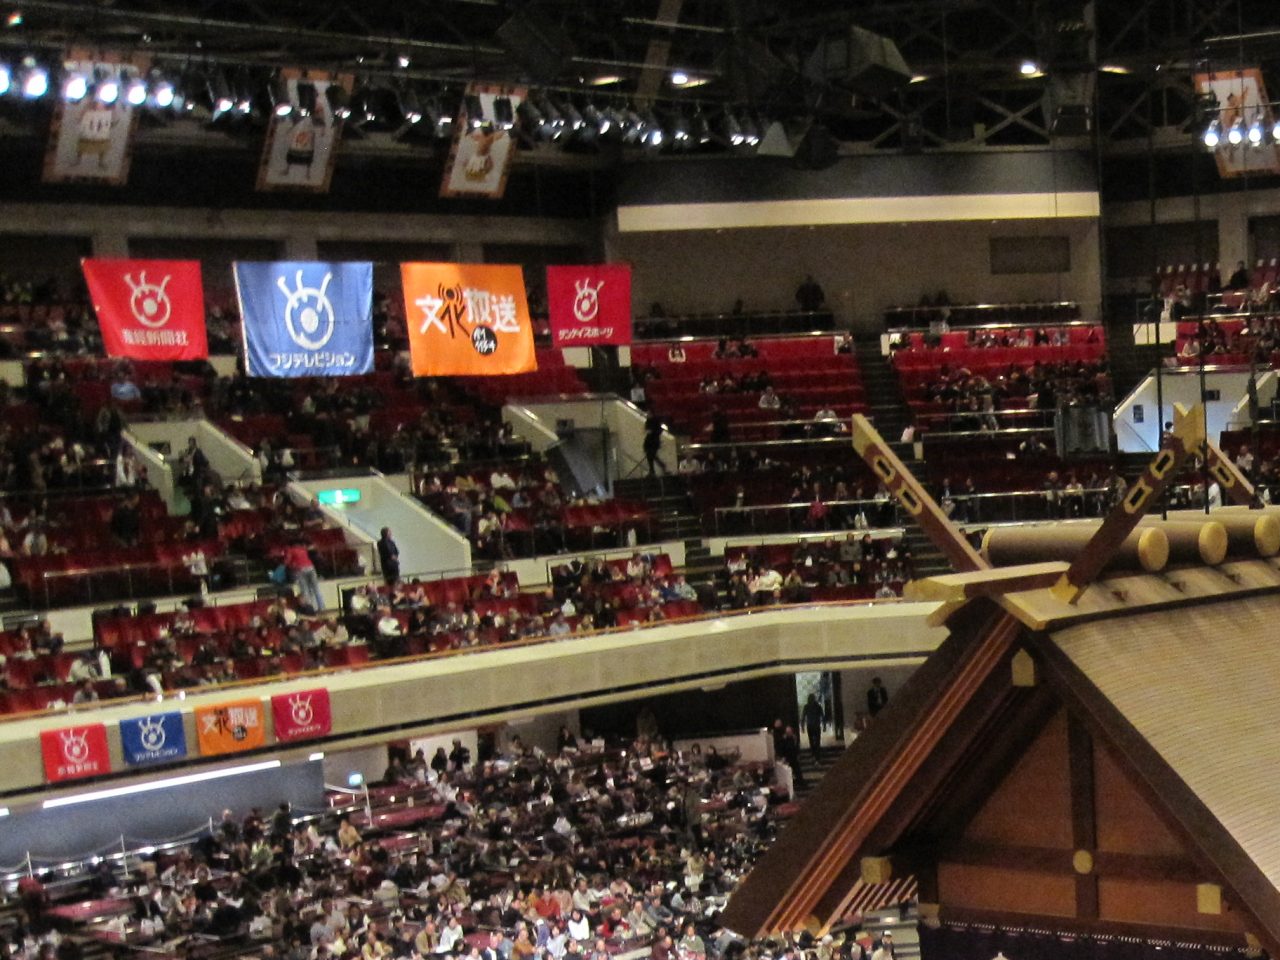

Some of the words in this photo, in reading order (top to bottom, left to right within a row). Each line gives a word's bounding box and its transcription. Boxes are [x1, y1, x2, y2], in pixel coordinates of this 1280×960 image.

[416, 286, 520, 338] 文化放送
[269, 352, 356, 369] フジテレビジョン
